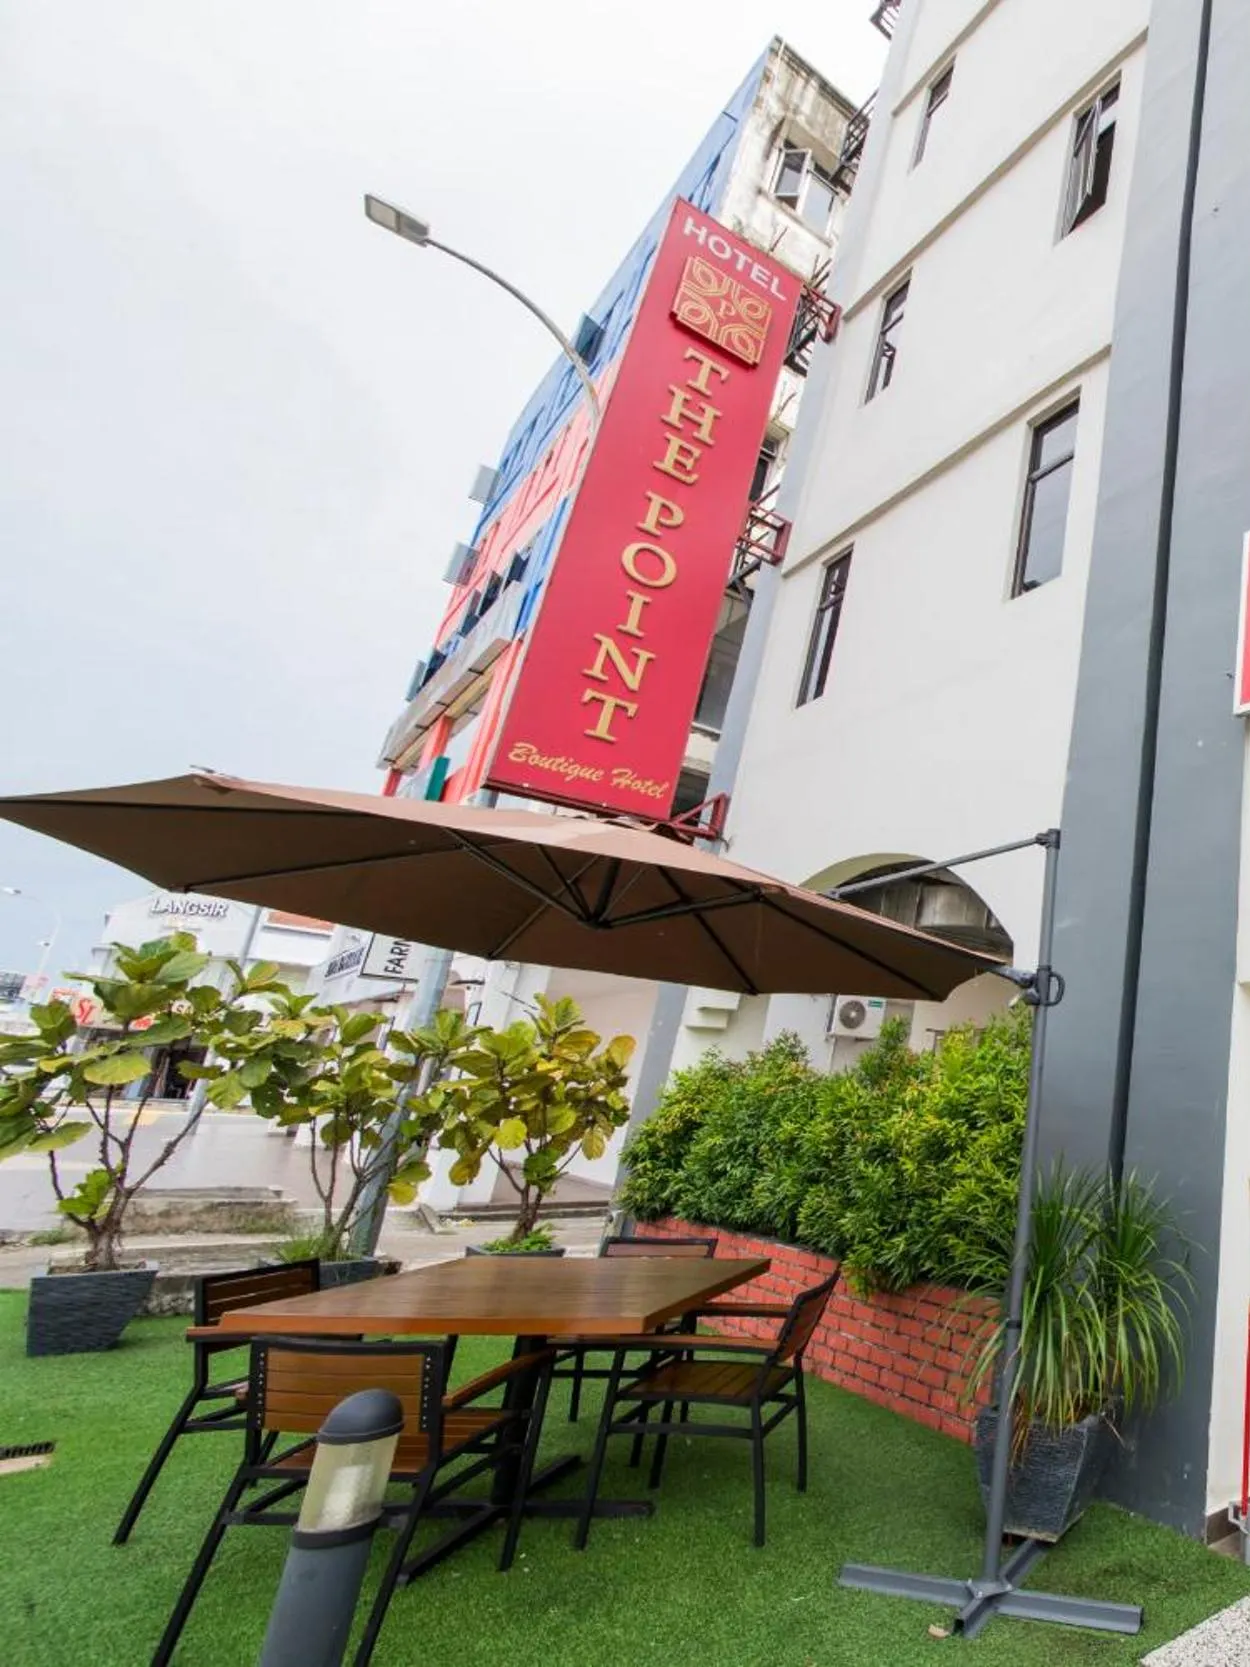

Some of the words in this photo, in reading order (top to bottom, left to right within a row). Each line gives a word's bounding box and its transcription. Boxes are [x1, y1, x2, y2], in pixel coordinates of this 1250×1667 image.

[682, 215, 787, 302] HOTEL
[652, 346, 730, 486] THE
[581, 489, 685, 744] POINT
[508, 741, 603, 782] Boutique
[610, 767, 669, 799] Hotel
[150, 897, 229, 918] LANGSIR
